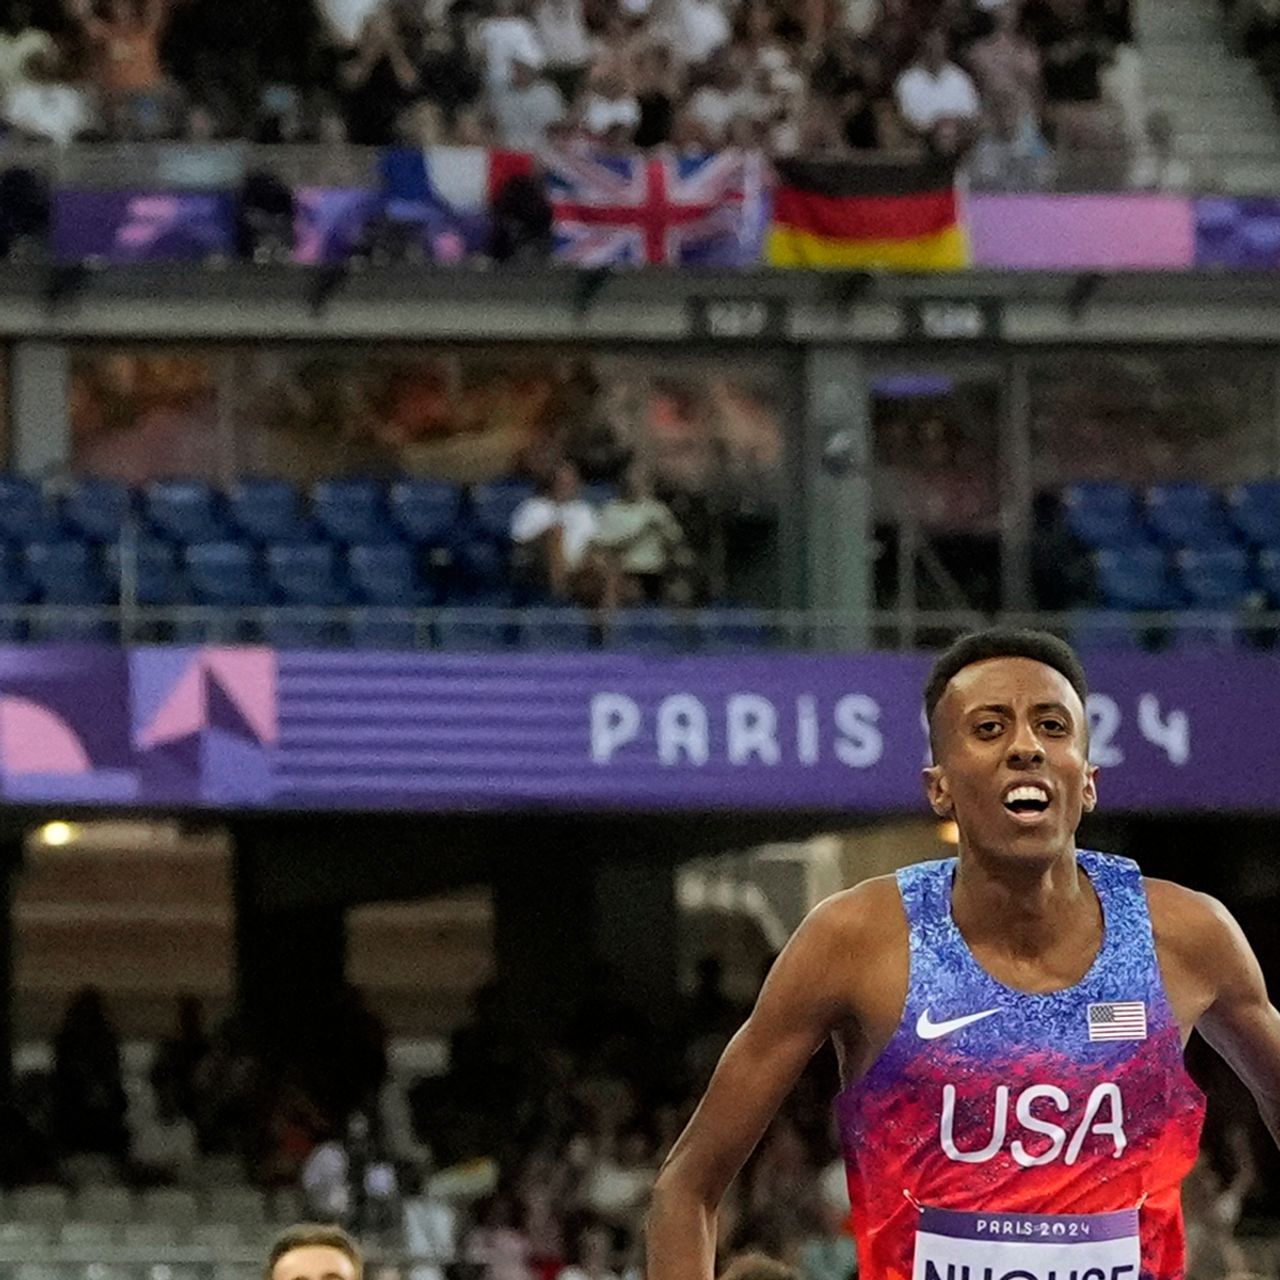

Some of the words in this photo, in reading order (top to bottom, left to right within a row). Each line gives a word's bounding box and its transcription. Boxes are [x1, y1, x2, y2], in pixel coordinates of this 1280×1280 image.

[588, 693, 885, 767] PARIS
[940, 1083, 1128, 1168] USA
[976, 1219, 1033, 1235] PARIS
[1040, 1221, 1090, 1236] 2024
